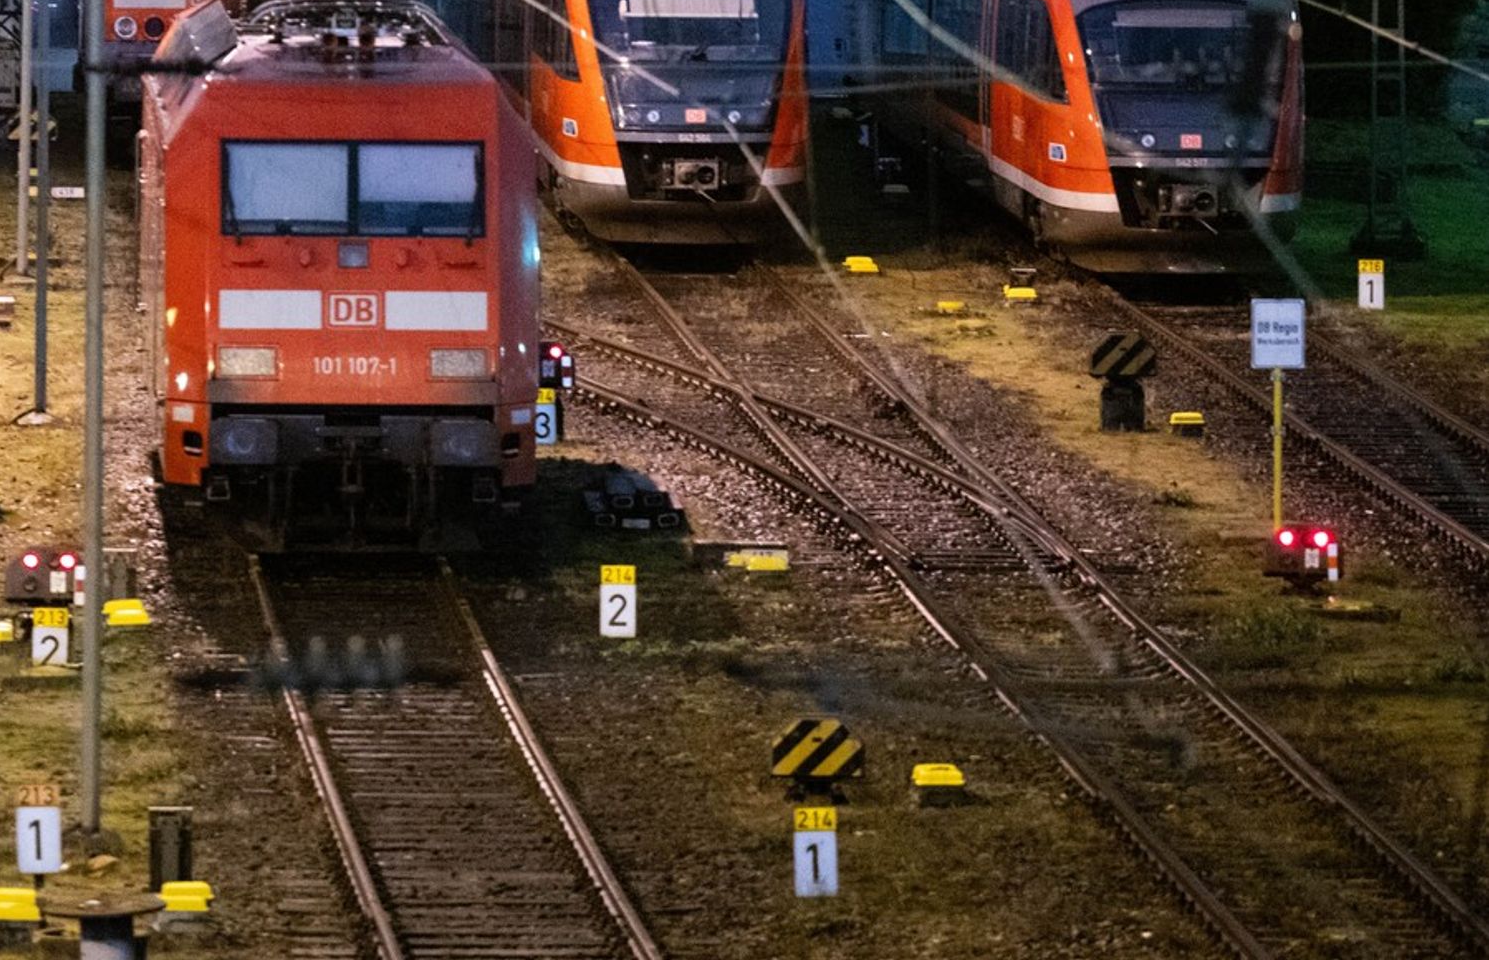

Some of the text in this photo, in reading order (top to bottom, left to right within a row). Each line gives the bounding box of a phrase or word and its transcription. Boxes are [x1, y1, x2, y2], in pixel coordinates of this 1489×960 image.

[1360, 261, 1381, 272] 216
[333, 297, 374, 322] DB
[1272, 321, 1299, 336] Regio
[313, 356, 397, 375] 101 107-1
[536, 412, 550, 438] 3
[603, 567, 632, 582] 214
[36, 610, 66, 625] 213
[608, 593, 627, 627] 2
[40, 635, 60, 665] 2
[19, 786, 55, 806] 213
[797, 810, 833, 829] 214
[28, 819, 42, 861] 1
[806, 843, 819, 884] 1
